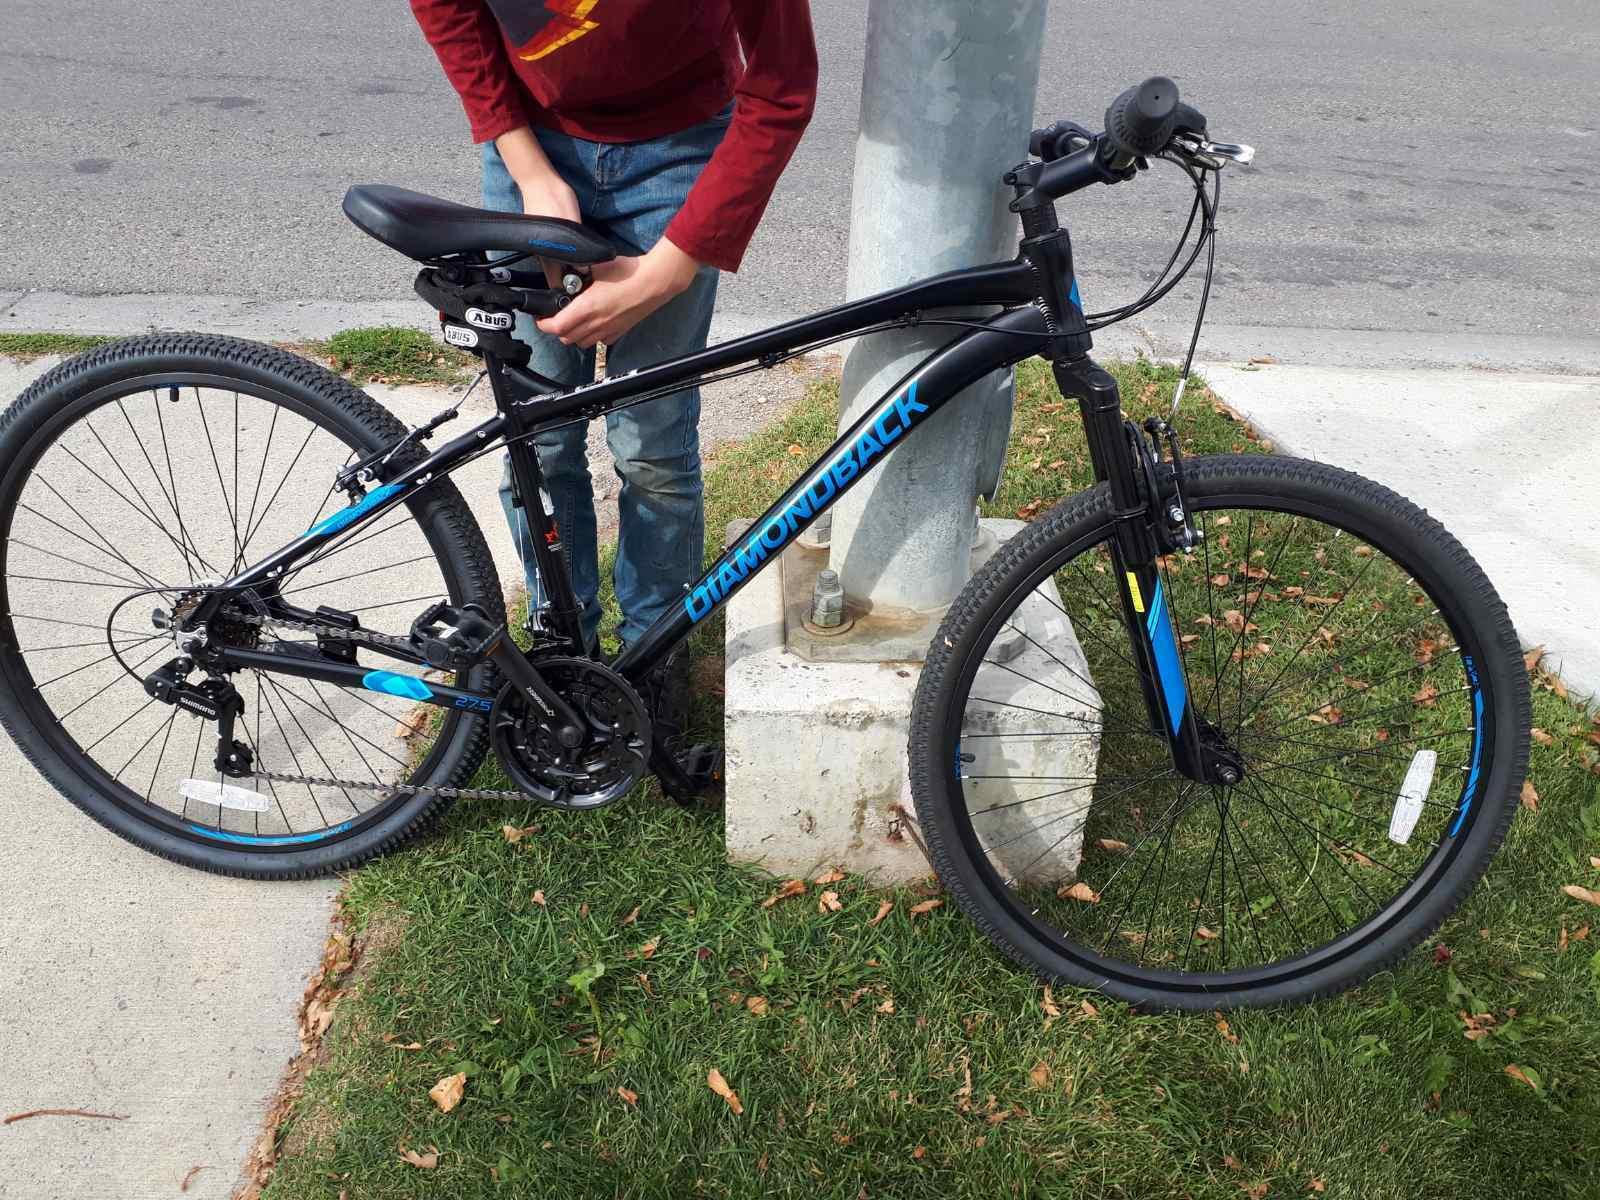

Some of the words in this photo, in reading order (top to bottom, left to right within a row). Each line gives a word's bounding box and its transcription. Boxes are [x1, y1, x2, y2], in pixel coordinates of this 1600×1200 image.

[473, 312, 508, 327] ABUS
[684, 379, 928, 623] DIAMONDBACK
[180, 697, 216, 716] SHIMANO
